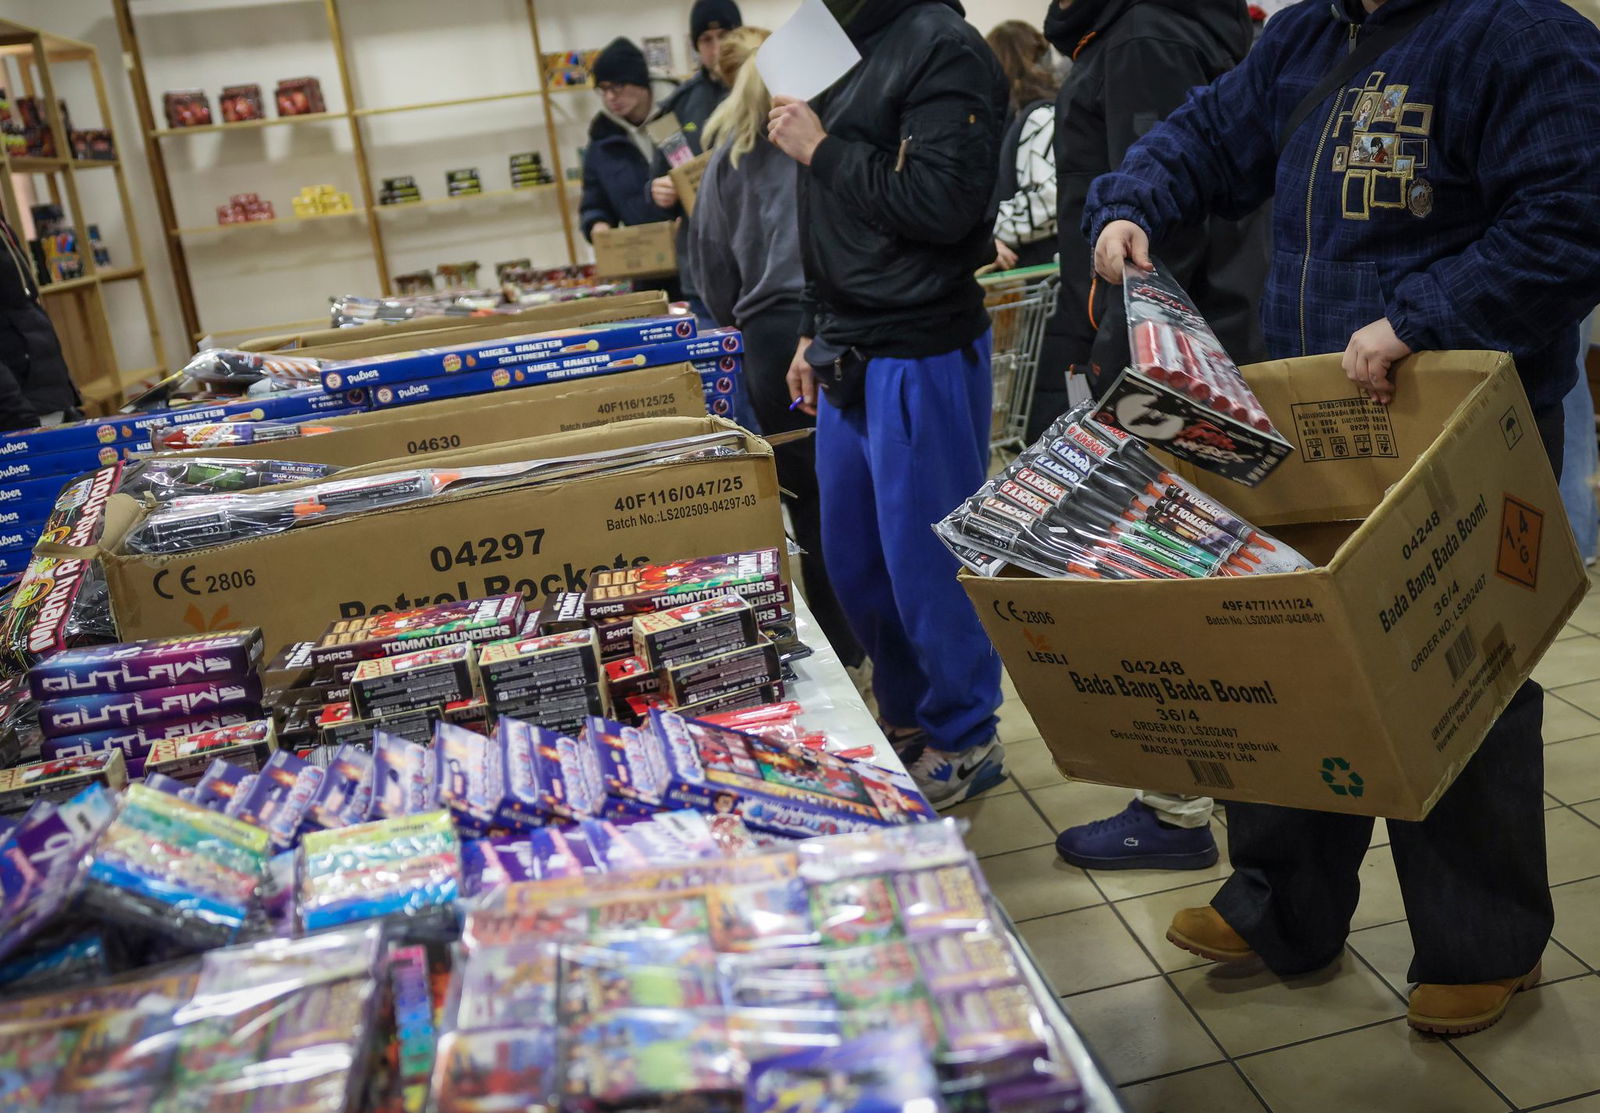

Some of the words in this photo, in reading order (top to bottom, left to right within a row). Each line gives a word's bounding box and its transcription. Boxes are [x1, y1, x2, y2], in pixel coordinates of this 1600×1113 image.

[479, 348, 512, 358] KUGEL
[515, 340, 563, 353] RAKETEN
[498, 350, 551, 364] SORTIMENT
[528, 361, 560, 373] KUGEL
[563, 354, 610, 368] RAKETEN
[547, 365, 599, 379] SORTIMENT
[598, 393, 675, 414] 40F116/125/25
[174, 409, 225, 423] RAKETEN
[408, 434, 460, 454] 04630
[1024, 471, 1061, 497] ROCKY
[614, 476, 743, 512] 40F116/047/25
[1008, 486, 1044, 511] ROCKY
[606, 516, 638, 531] Batch
[1175, 506, 1211, 532] PETROL
[1402, 510, 1440, 560] 04248
[430, 529, 546, 573] 04297
[1379, 595, 1410, 634] Bada
[1406, 563, 1436, 602] Bang
[1432, 532, 1460, 570] Bada
[1456, 494, 1488, 542] Boom!
[205, 569, 256, 594] 2806
[1222, 598, 1314, 612] 49F477/111/24
[1433, 580, 1460, 616] 36/4
[590, 604, 624, 616] 24PCS
[1022, 610, 1056, 625] 2806
[1206, 616, 1230, 626] Batch
[1410, 636, 1440, 672] ORDER
[1454, 574, 1488, 622] LS202407
[606, 626, 634, 640] 24PC
[317, 651, 353, 663] 24PCS
[1027, 651, 1068, 665] LESLI
[1120, 660, 1184, 675] 04248
[1069, 671, 1116, 696] Bada
[1113, 674, 1165, 704] Bang
[1160, 678, 1212, 701] Bada
[1210, 680, 1278, 704] Boom!
[1156, 708, 1200, 722] 36/4
[1133, 720, 1170, 732] ORDER
[1190, 727, 1238, 738] LS202407
[1110, 730, 1155, 742] Geschikt
[1156, 735, 1178, 744] voor
[1180, 738, 1234, 749] particulier
[1236, 742, 1280, 754] gebruik
[1141, 744, 1170, 755] MADE
[1172, 747, 1182, 756] IN
[1184, 749, 1217, 760] CHINA
[1218, 752, 1232, 760] BY
